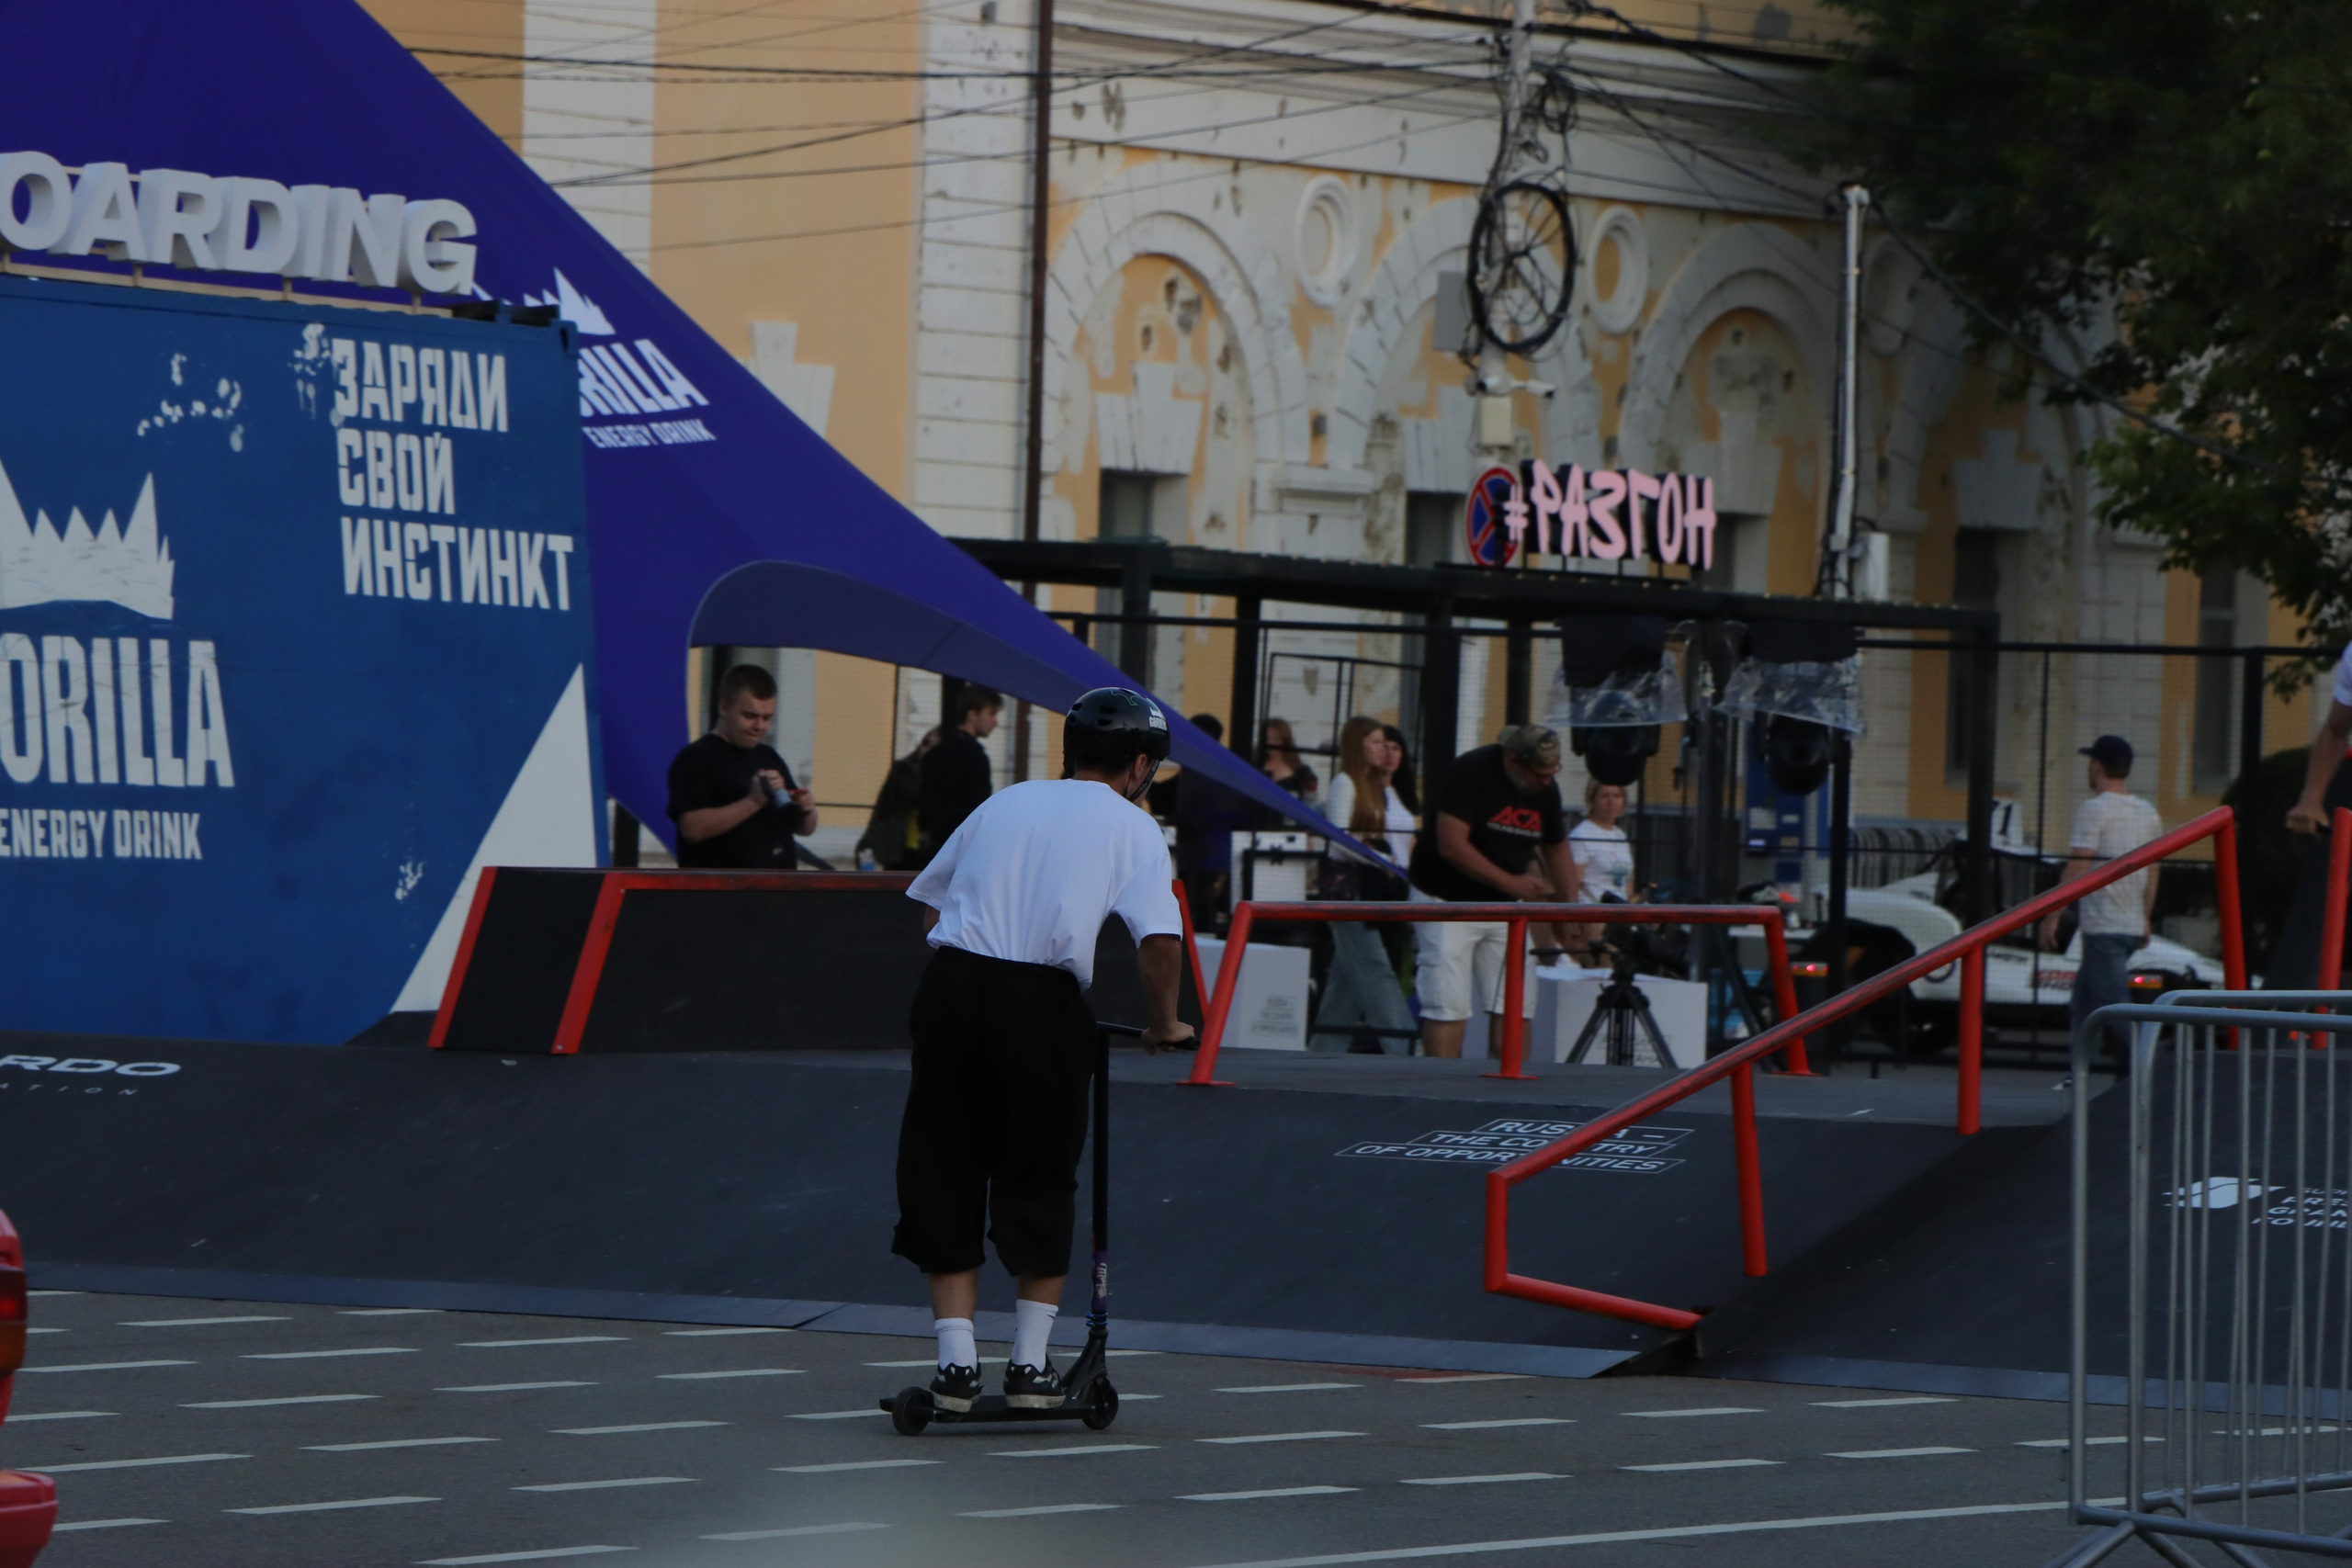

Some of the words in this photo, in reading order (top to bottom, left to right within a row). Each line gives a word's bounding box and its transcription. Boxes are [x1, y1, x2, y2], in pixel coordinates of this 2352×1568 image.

[0, 151, 478, 295] OARDING
[332, 337, 509, 433] ЗАРЯДИ
[336, 427, 456, 514] СВОЙ
[582, 424, 659, 449] ENERGY
[649, 419, 717, 446] DRINK
[340, 515, 574, 611] ИНСТИНКТ
[0, 632, 236, 787] ORILLA
[0, 807, 107, 858] ENERGY
[112, 809, 203, 860] DRINK
[1354, 1145, 1408, 1156] OF
[1430, 1133, 1500, 1146] THE
[1498, 1136, 1657, 1155] COTRY
